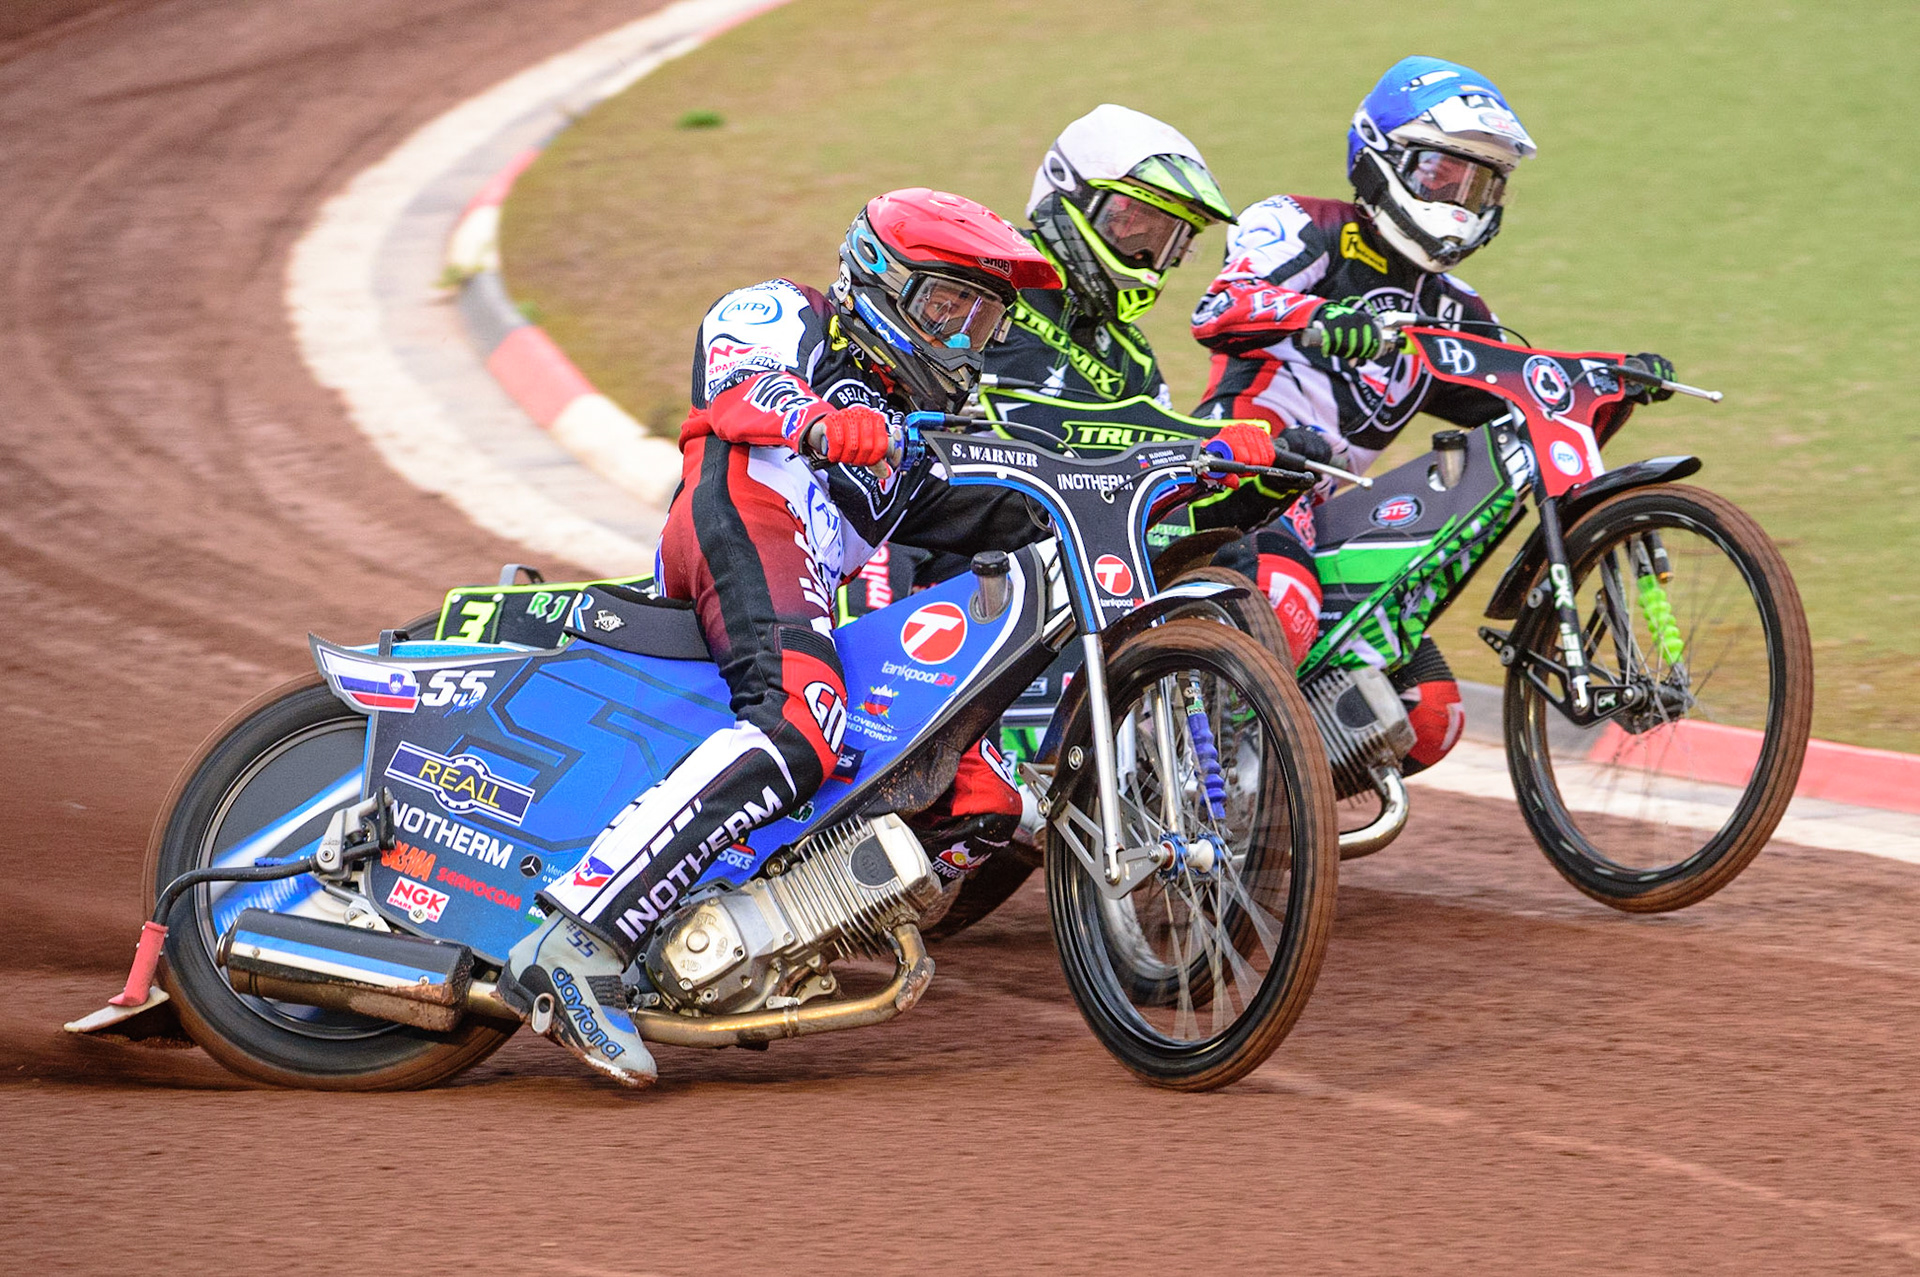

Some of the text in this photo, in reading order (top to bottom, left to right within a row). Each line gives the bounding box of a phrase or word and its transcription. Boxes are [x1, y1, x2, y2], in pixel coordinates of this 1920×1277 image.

[836, 387, 872, 407] BELLE
[951, 443, 1039, 468] S. WARNER
[1056, 474, 1134, 491] INOTHERM
[1377, 503, 1413, 519] STS
[446, 591, 571, 643] 3 RJ
[420, 670, 496, 708] 55
[881, 660, 957, 687] tankpool24
[418, 760, 501, 809] REALL
[389, 800, 514, 869] NOTHERM
[615, 785, 783, 943] INOTHERM
[393, 879, 447, 914] NGK
[551, 966, 626, 1062] daytona
